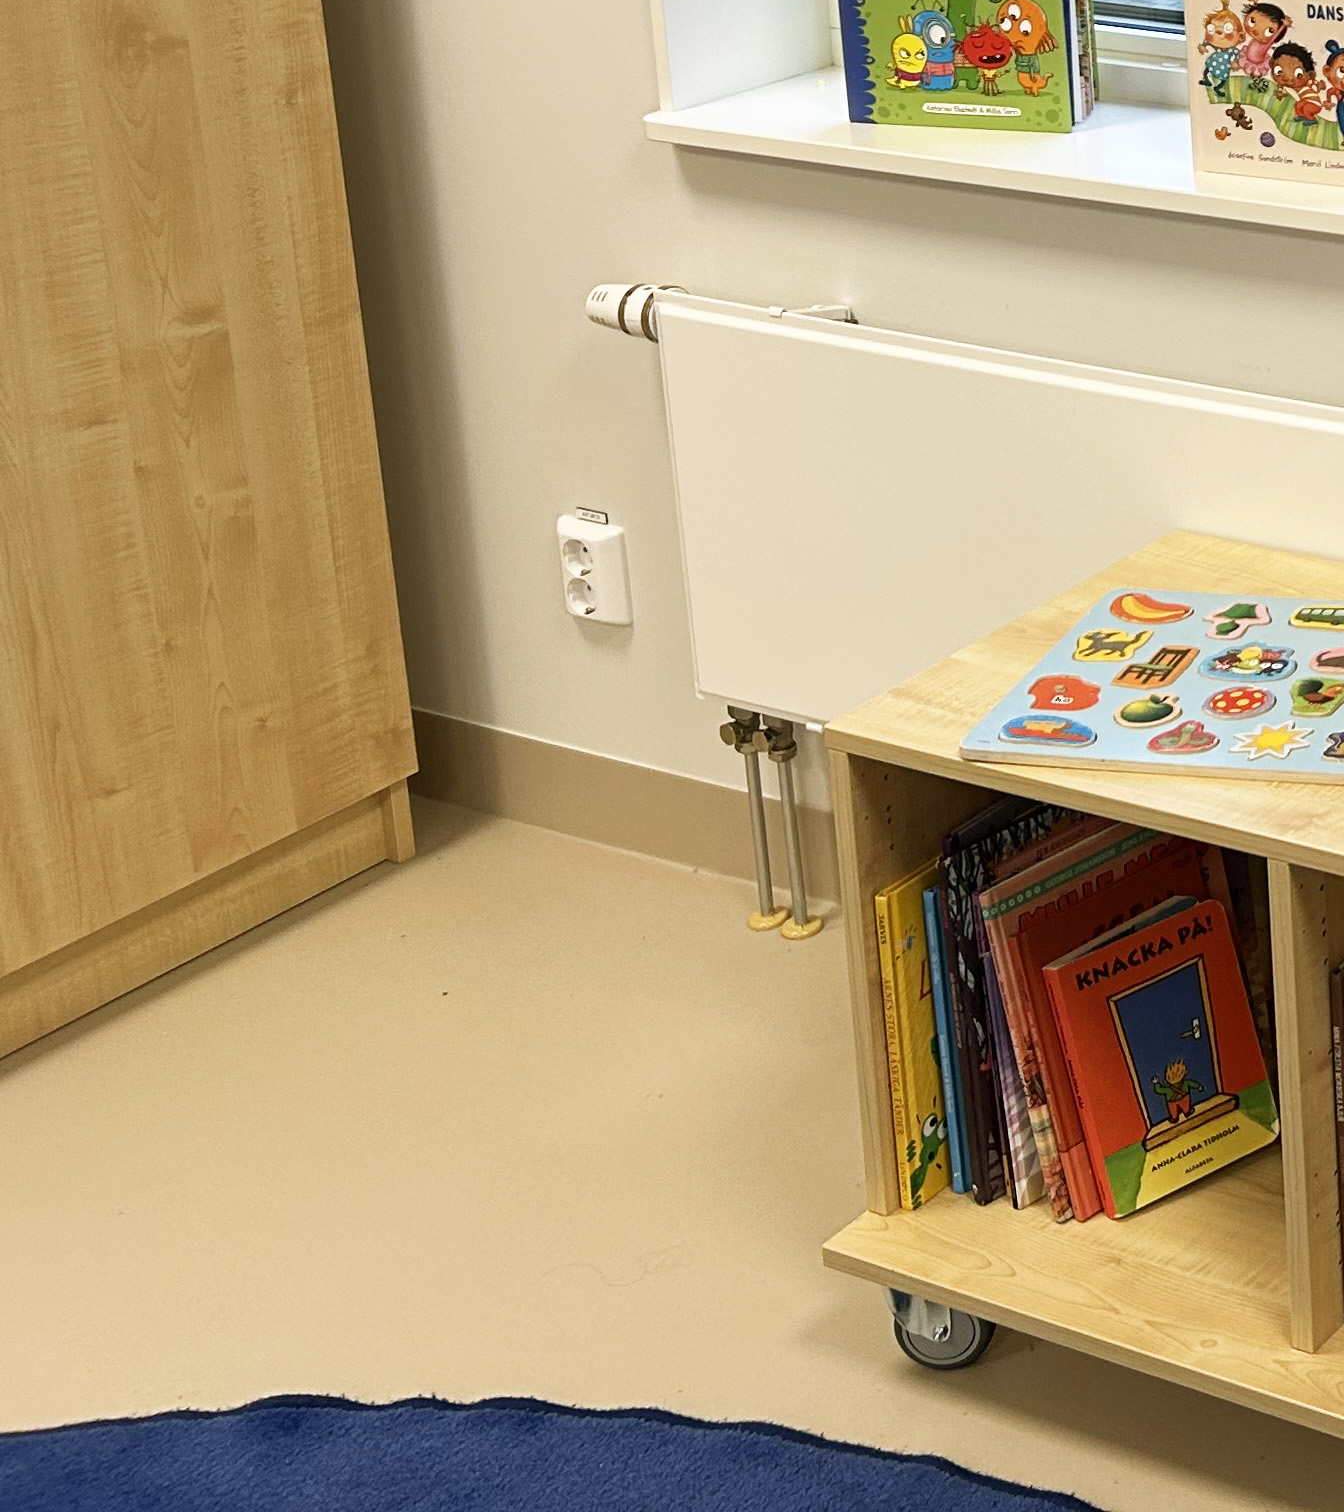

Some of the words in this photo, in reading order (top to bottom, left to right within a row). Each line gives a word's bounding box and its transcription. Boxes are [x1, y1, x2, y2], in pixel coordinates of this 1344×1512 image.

[877, 915, 887, 945] JARVIS
[1074, 931, 1174, 992] KNACKA
[1178, 913, 1214, 947] PÅ!
[892, 1097, 906, 1136] TÄNDER
[1151, 1143, 1202, 1173] ANNA-CLARA
[1203, 1125, 1240, 1147] TIDHOLM
